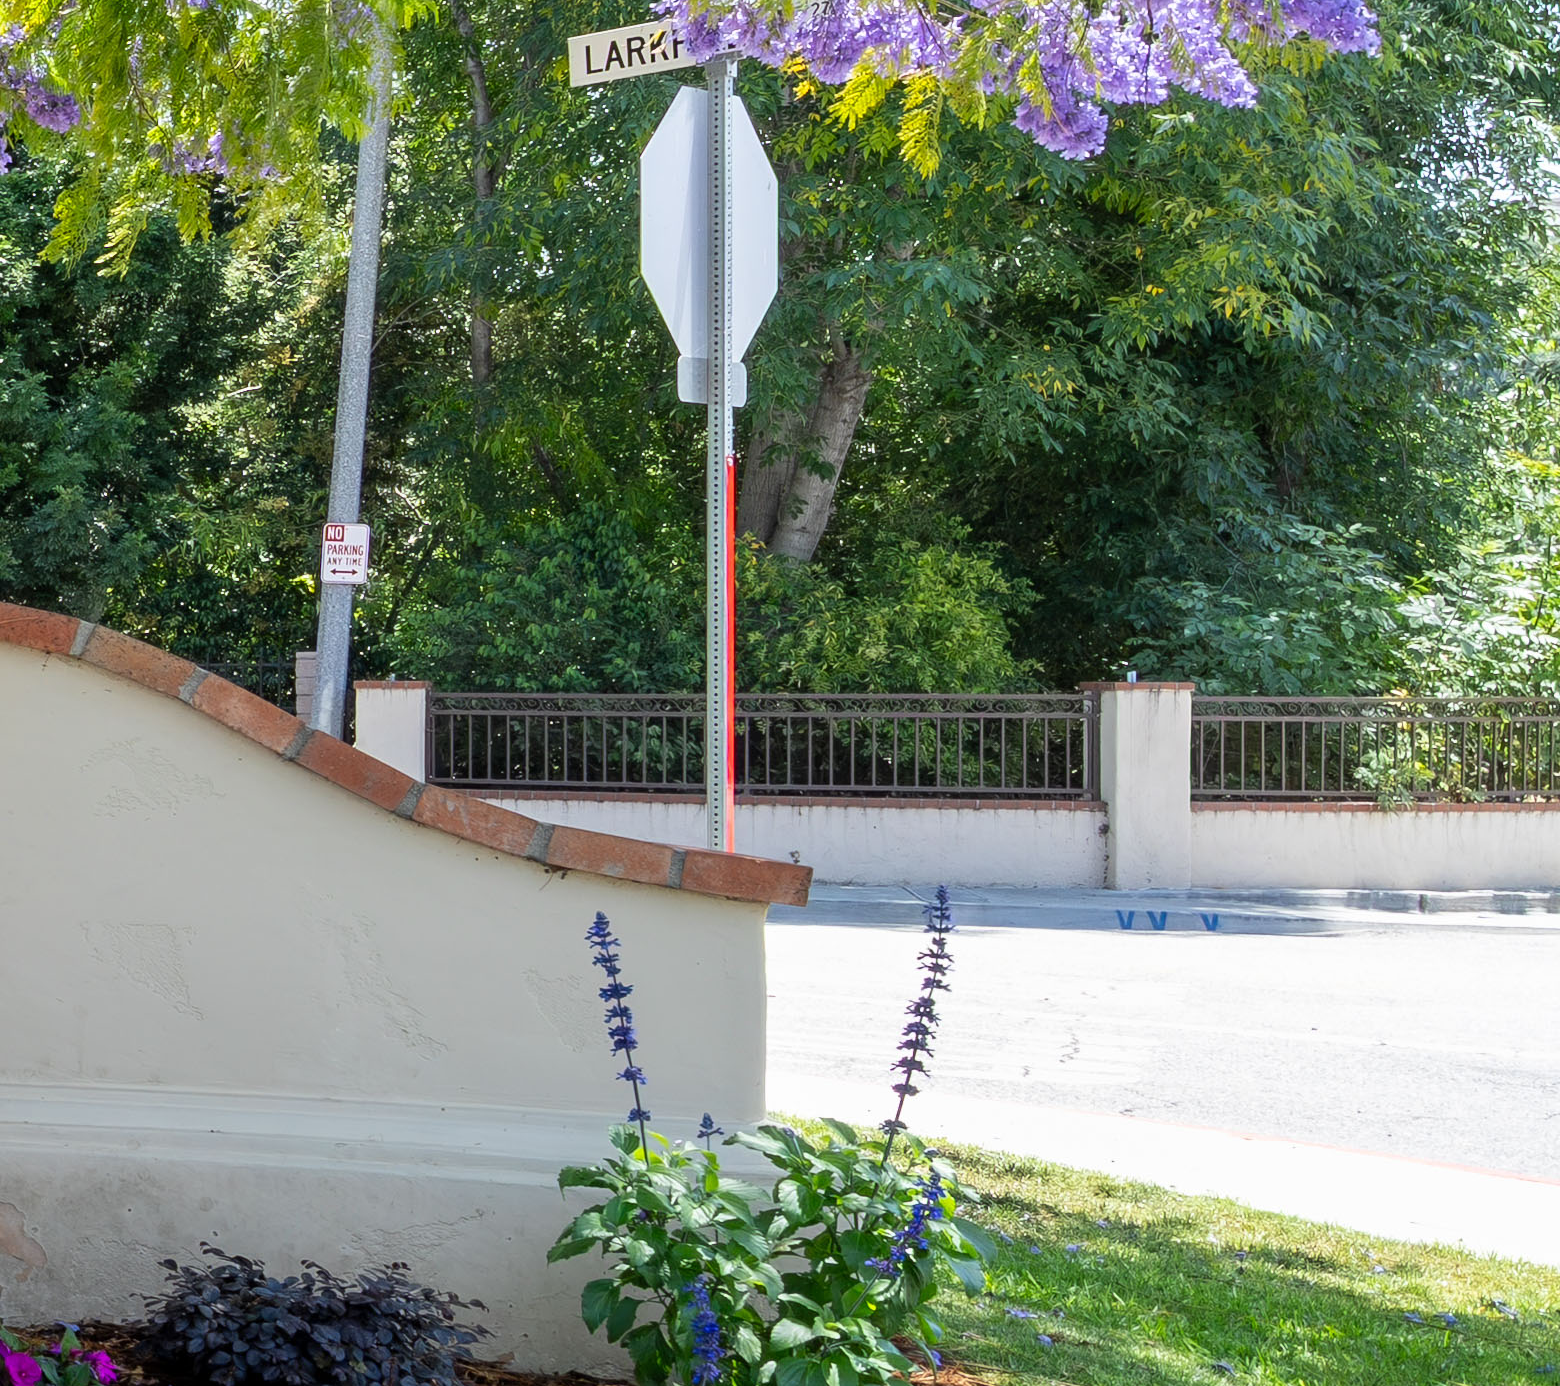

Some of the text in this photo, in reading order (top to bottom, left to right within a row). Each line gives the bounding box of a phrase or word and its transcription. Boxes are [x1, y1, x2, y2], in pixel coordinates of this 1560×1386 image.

[327, 526, 343, 540] NO
[327, 544, 364, 556] PARKING
[327, 557, 362, 566] ANY TIME
